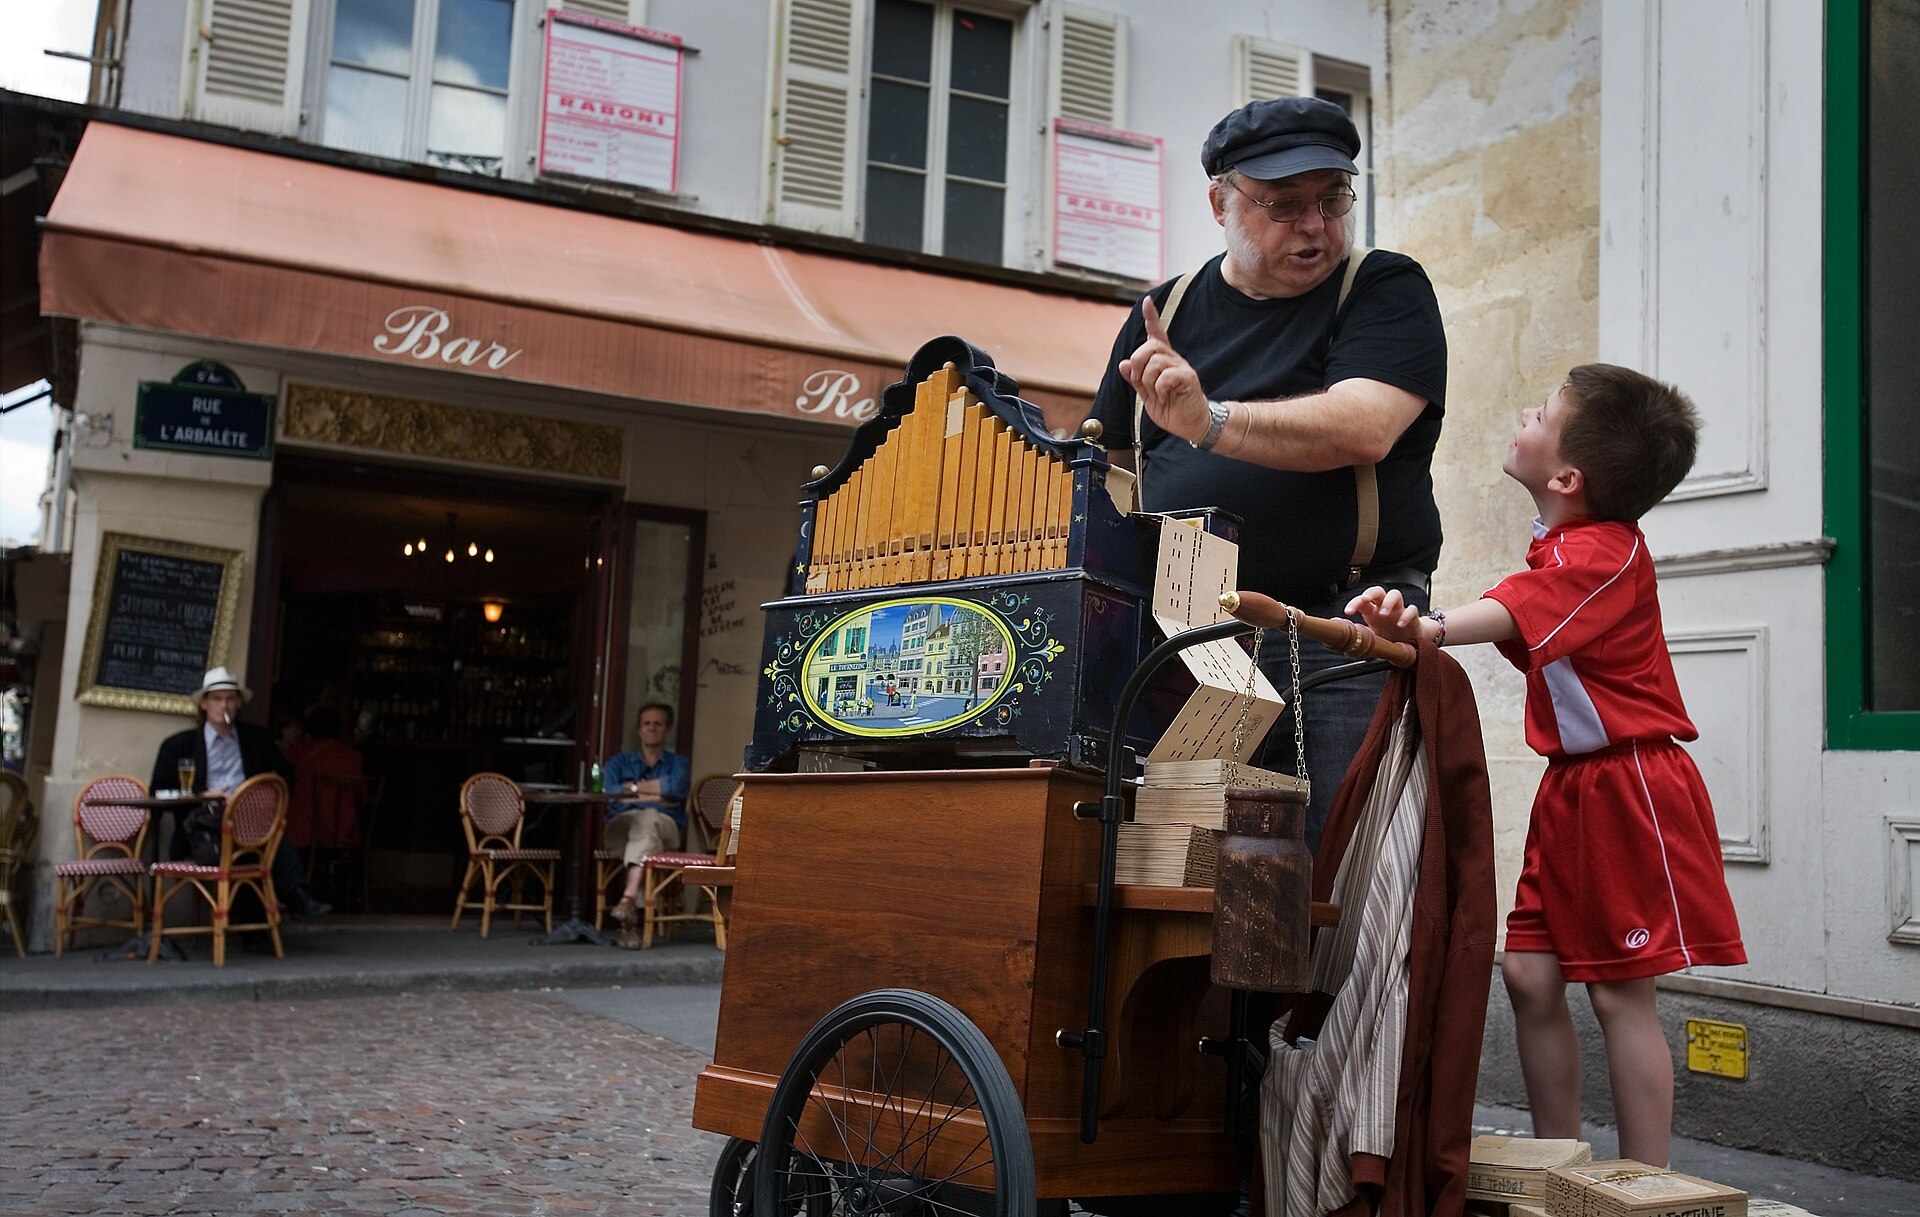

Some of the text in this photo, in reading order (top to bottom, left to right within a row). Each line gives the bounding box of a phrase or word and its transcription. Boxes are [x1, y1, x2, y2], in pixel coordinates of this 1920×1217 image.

[559, 95, 666, 126] RABONI
[1066, 195, 1153, 220] RABONI
[373, 305, 524, 370] Bar
[192, 396, 222, 415] RUE
[795, 369, 881, 422] Re
